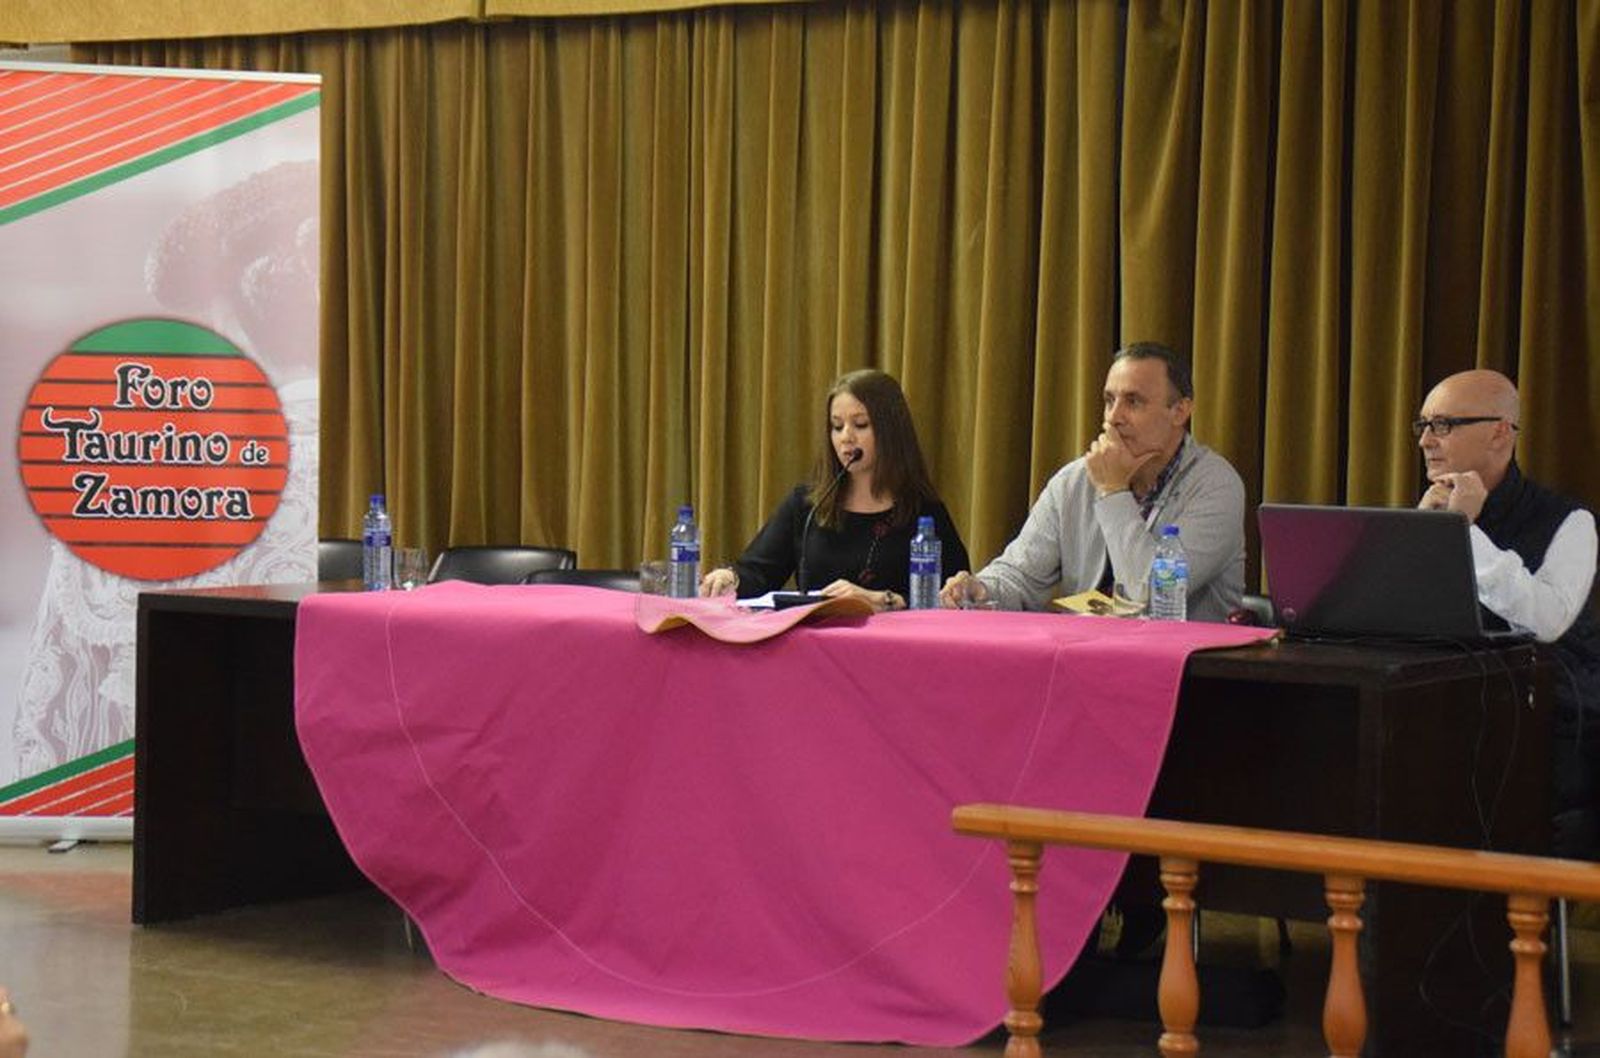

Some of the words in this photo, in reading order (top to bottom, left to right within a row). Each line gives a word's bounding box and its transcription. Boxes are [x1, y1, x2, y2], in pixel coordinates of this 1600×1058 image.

[115, 364, 212, 408] Foro
[43, 408, 229, 463] Taurino
[241, 440, 268, 465] de
[73, 473, 253, 519] Zamora
